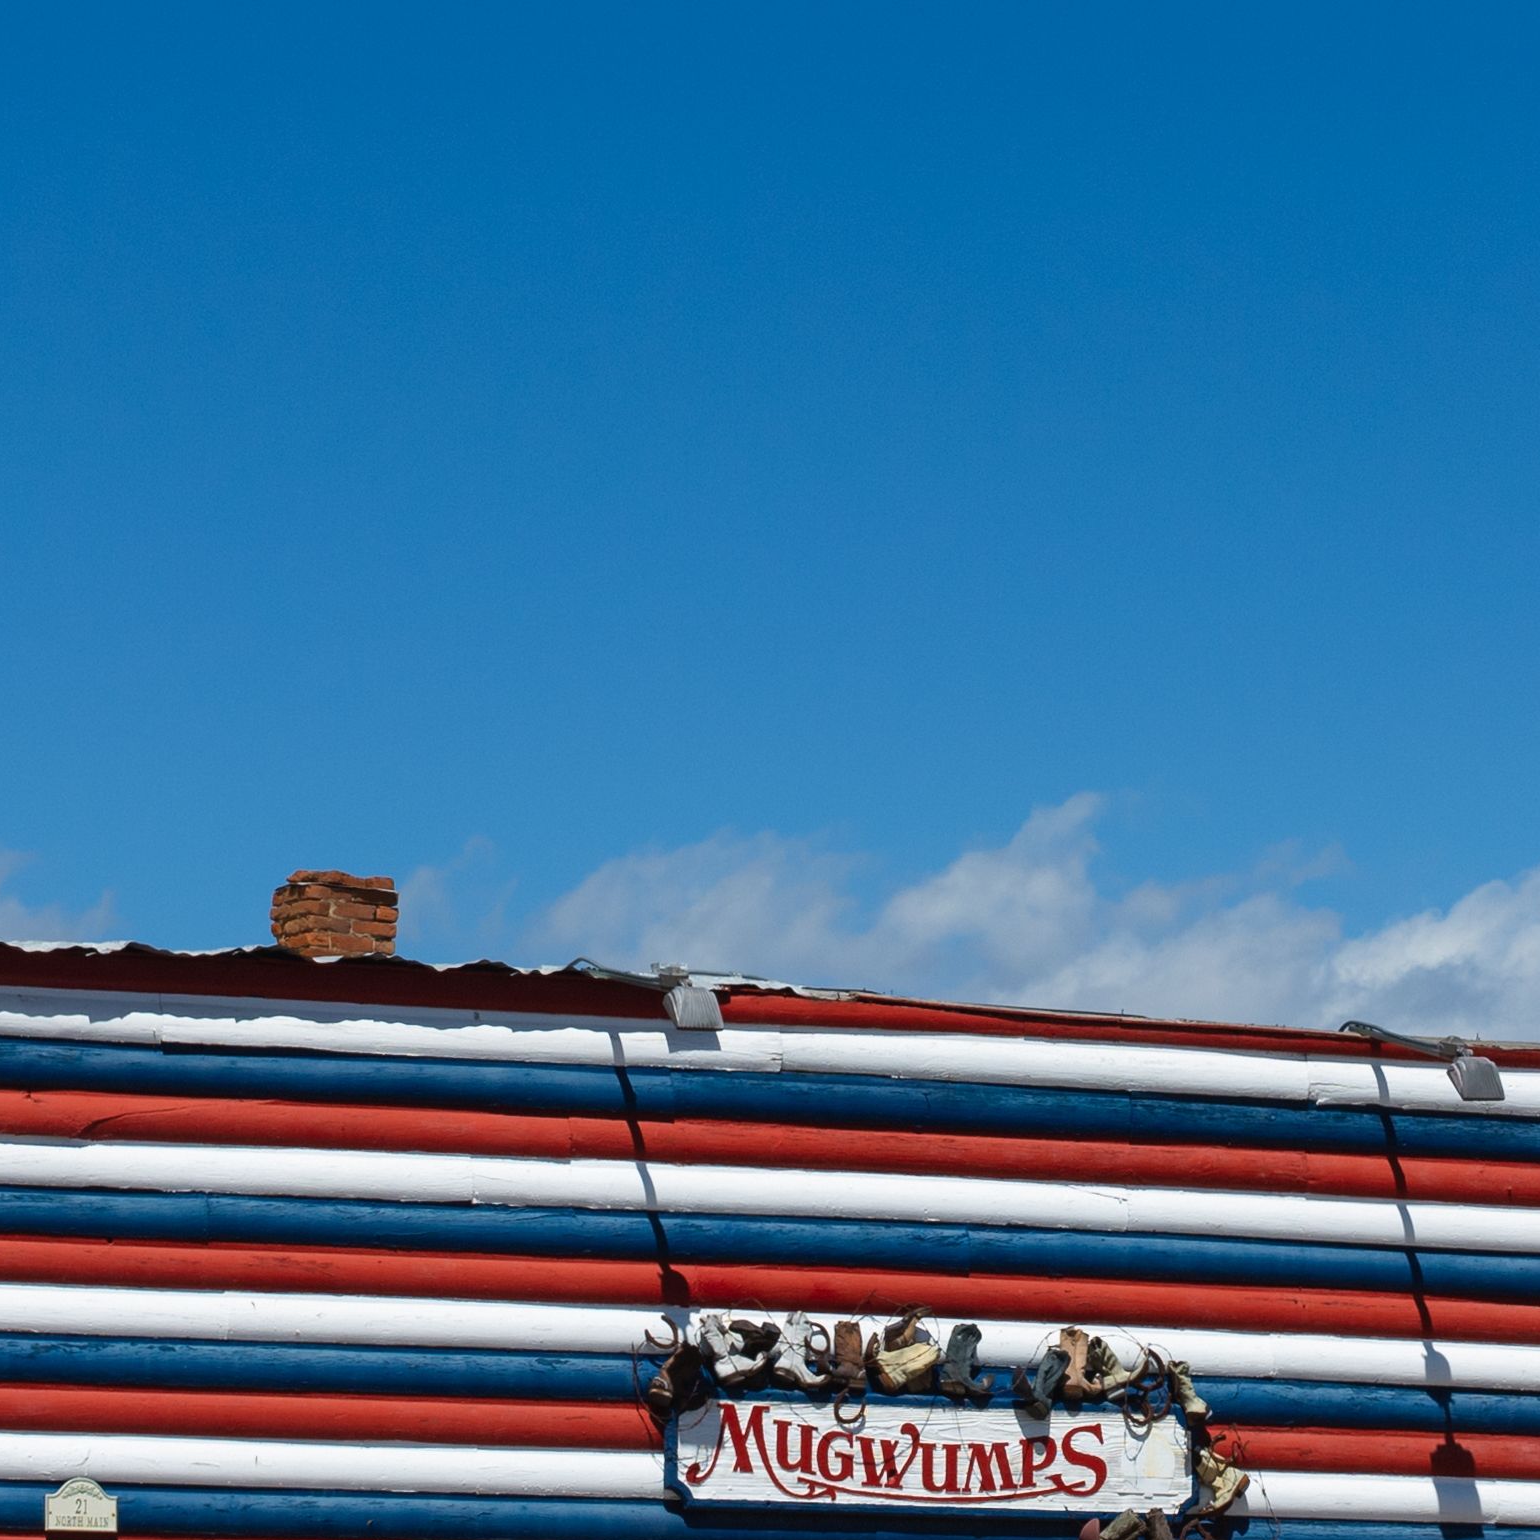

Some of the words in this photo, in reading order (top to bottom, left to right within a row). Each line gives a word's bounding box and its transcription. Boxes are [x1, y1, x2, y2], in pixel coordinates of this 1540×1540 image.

[686, 1402, 1108, 1502] MUGWUMPS
[75, 1498, 88, 1515] 21
[55, 1515, 84, 1528] NORTH
[86, 1516, 109, 1528] MAIN
